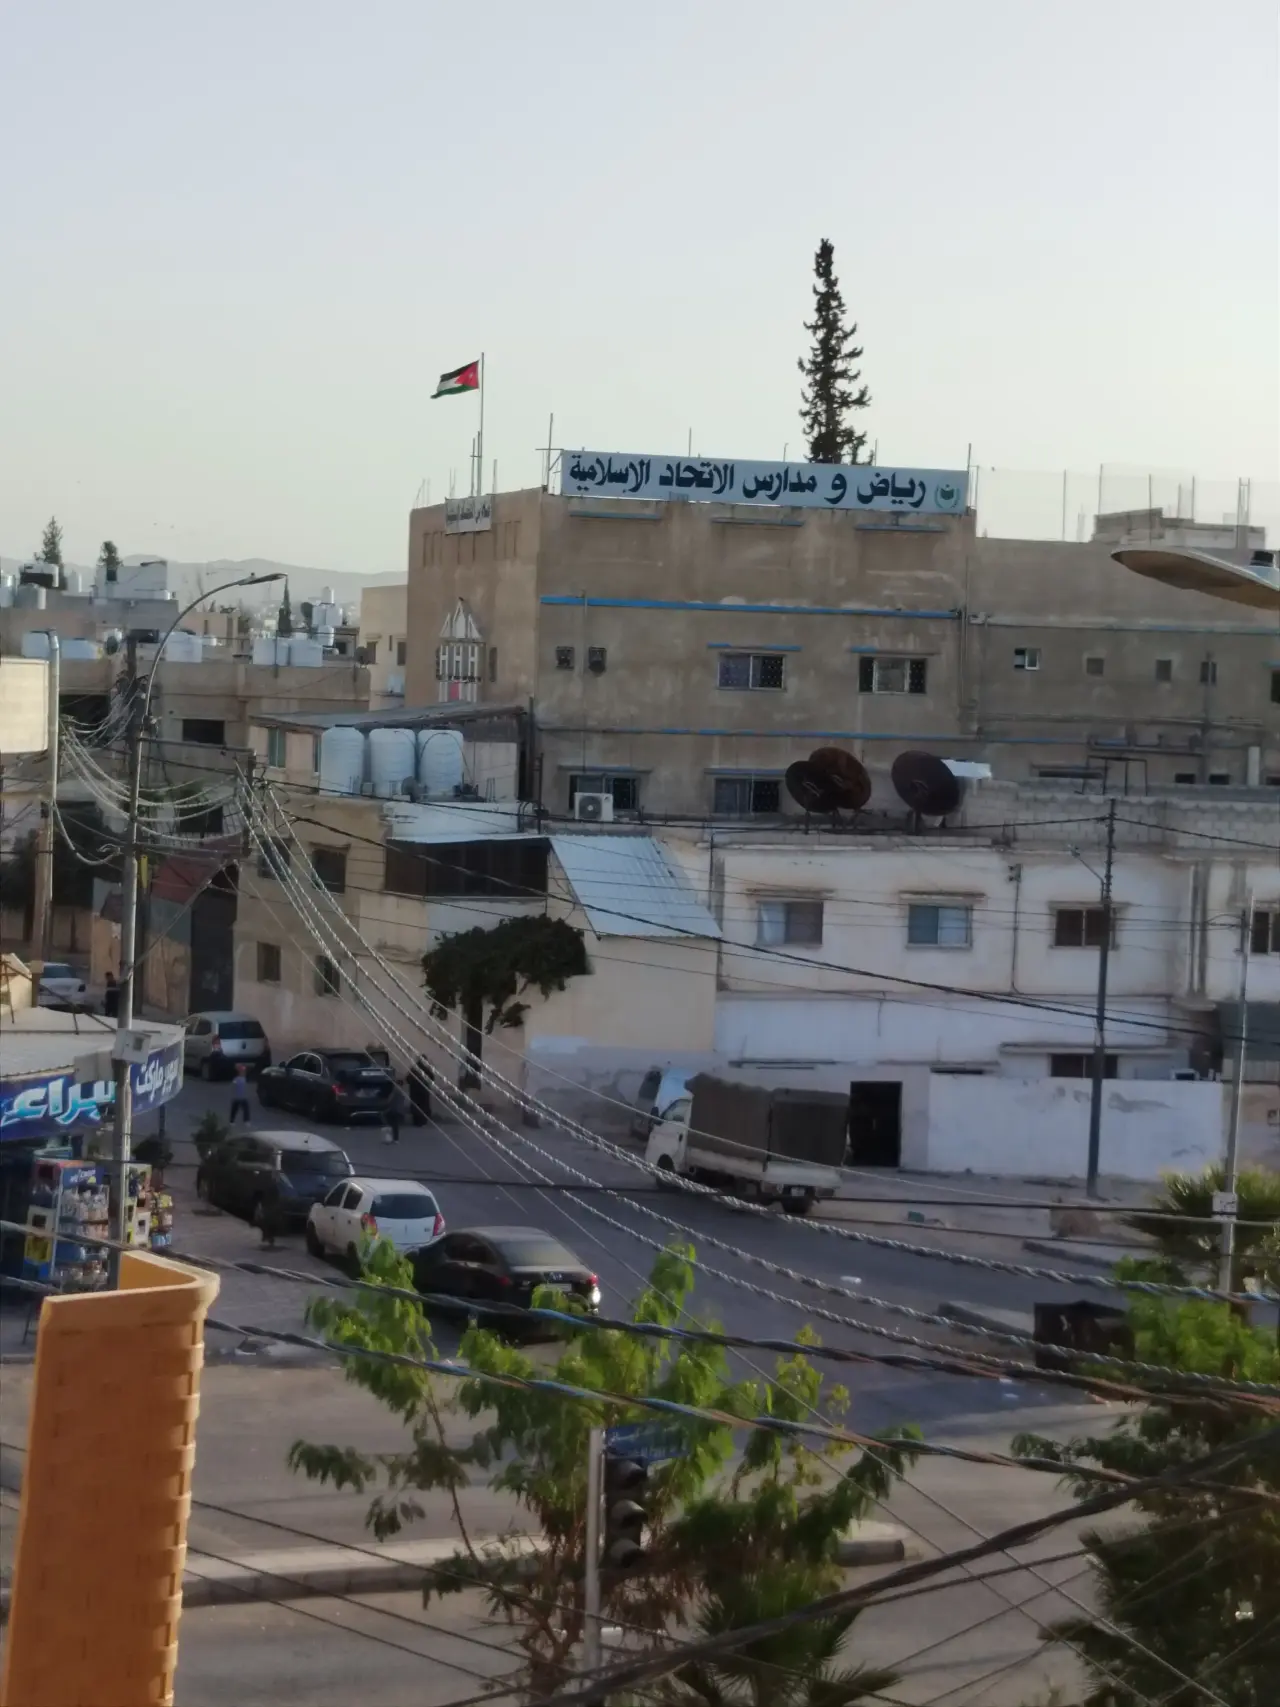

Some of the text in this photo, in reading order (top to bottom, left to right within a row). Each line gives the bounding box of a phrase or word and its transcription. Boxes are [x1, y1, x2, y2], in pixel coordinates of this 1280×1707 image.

[569, 454, 926, 508] رياض و مدارس الاتحاد الإسلامية
